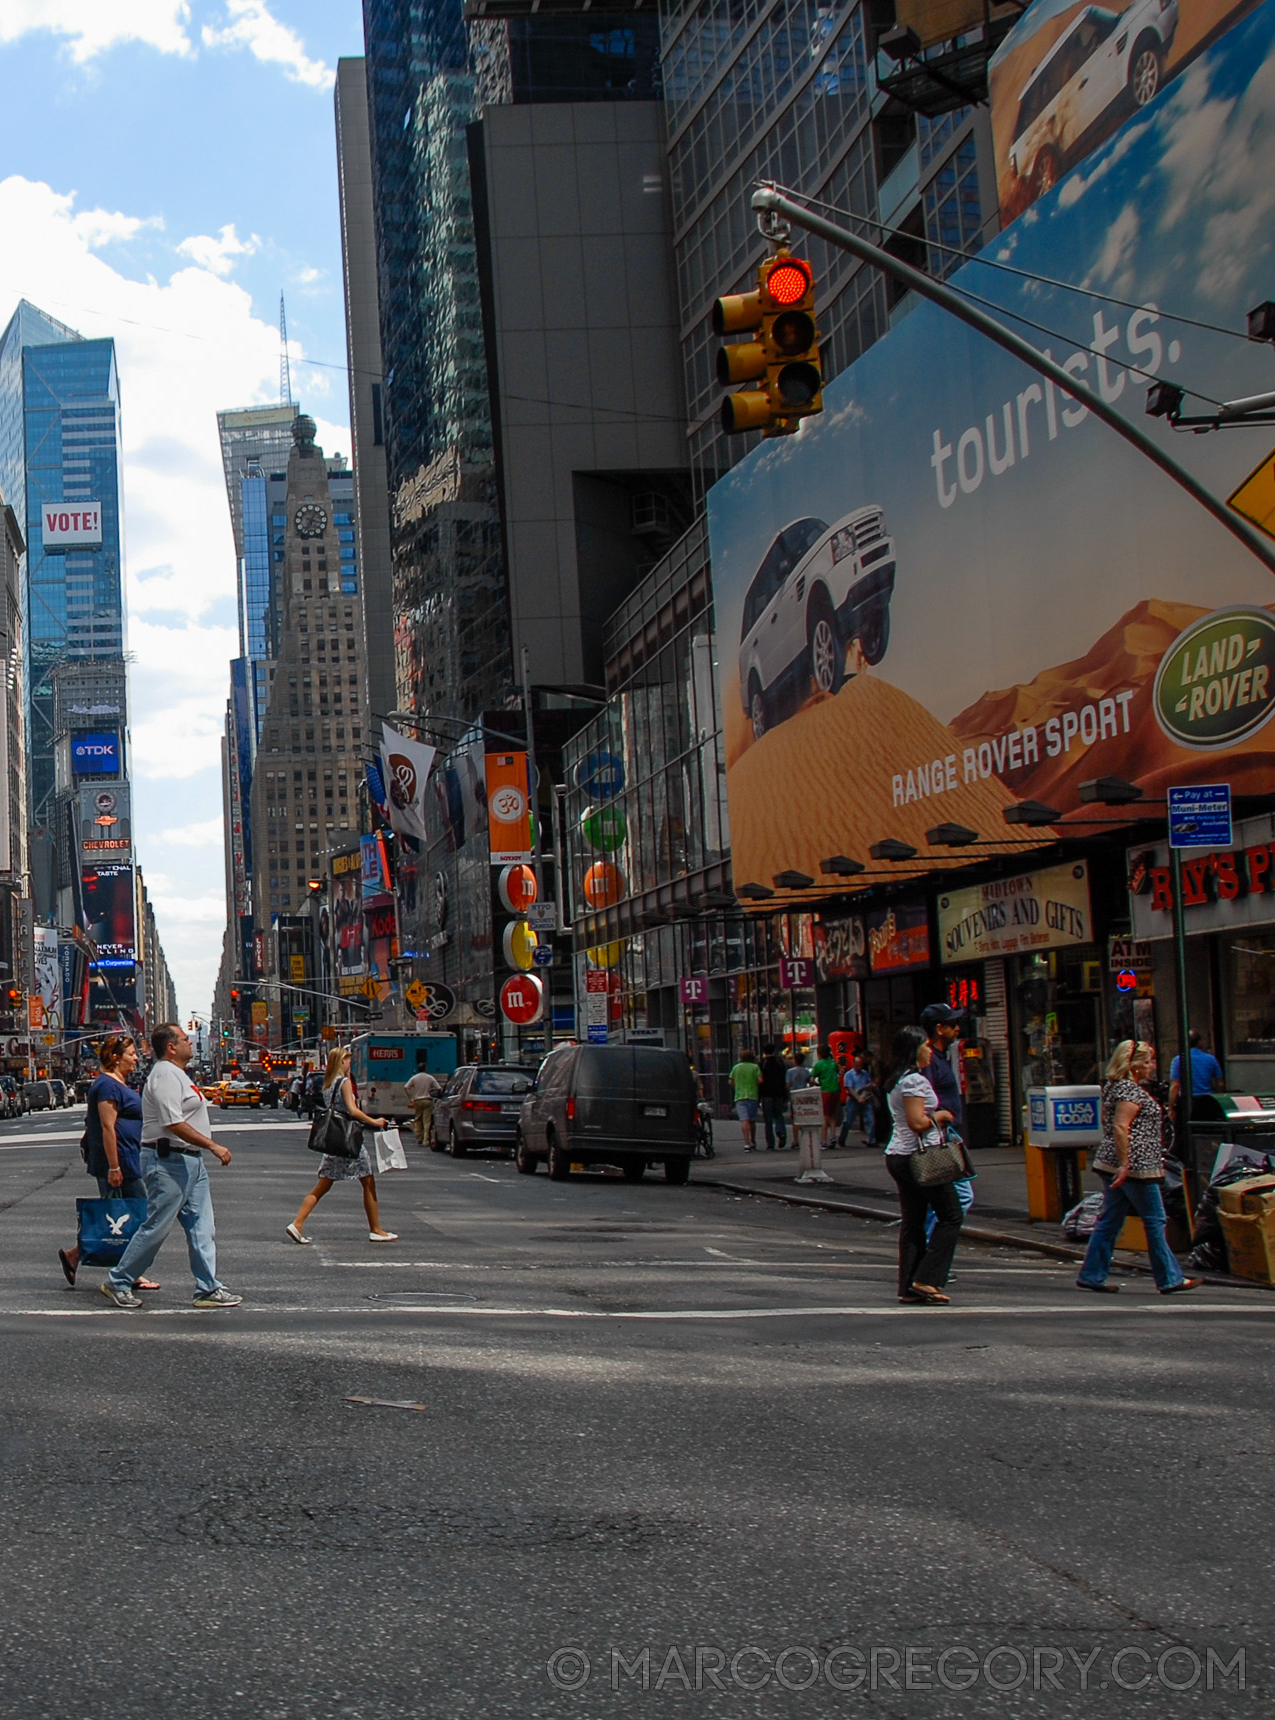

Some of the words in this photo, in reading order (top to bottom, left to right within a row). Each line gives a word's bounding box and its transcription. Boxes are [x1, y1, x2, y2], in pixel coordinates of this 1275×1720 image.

[931, 302, 1181, 508] tourists.
[47, 512, 98, 531] VOTE!
[1180, 633, 1243, 686] LAND
[1188, 665, 1269, 722] ROVER
[85, 745, 113, 755] TDK
[892, 754, 956, 807] RANGE
[964, 726, 1038, 785] ROVER
[1045, 690, 1134, 757] SPORT
[1185, 791, 1200, 800] Pay
[1172, 803, 1228, 813] Muni-Meter
[83, 841, 129, 849] CHEVROLET
[522, 880, 534, 895] m
[981, 876, 1033, 900] MIDTOWN
[372, 911, 397, 937] Koda
[1012, 897, 1039, 925] AND
[1045, 900, 1084, 939] GIFTS
[340, 925, 362, 948] UFC
[1112, 941, 1152, 957] ATM
[1111, 958, 1152, 967] INSIDE
[787, 961, 807, 984] T
[507, 990, 525, 1008] m
[685, 980, 702, 999] T
[1068, 1103, 1094, 1113] USA
[1057, 1113, 1095, 1124] TODAY
